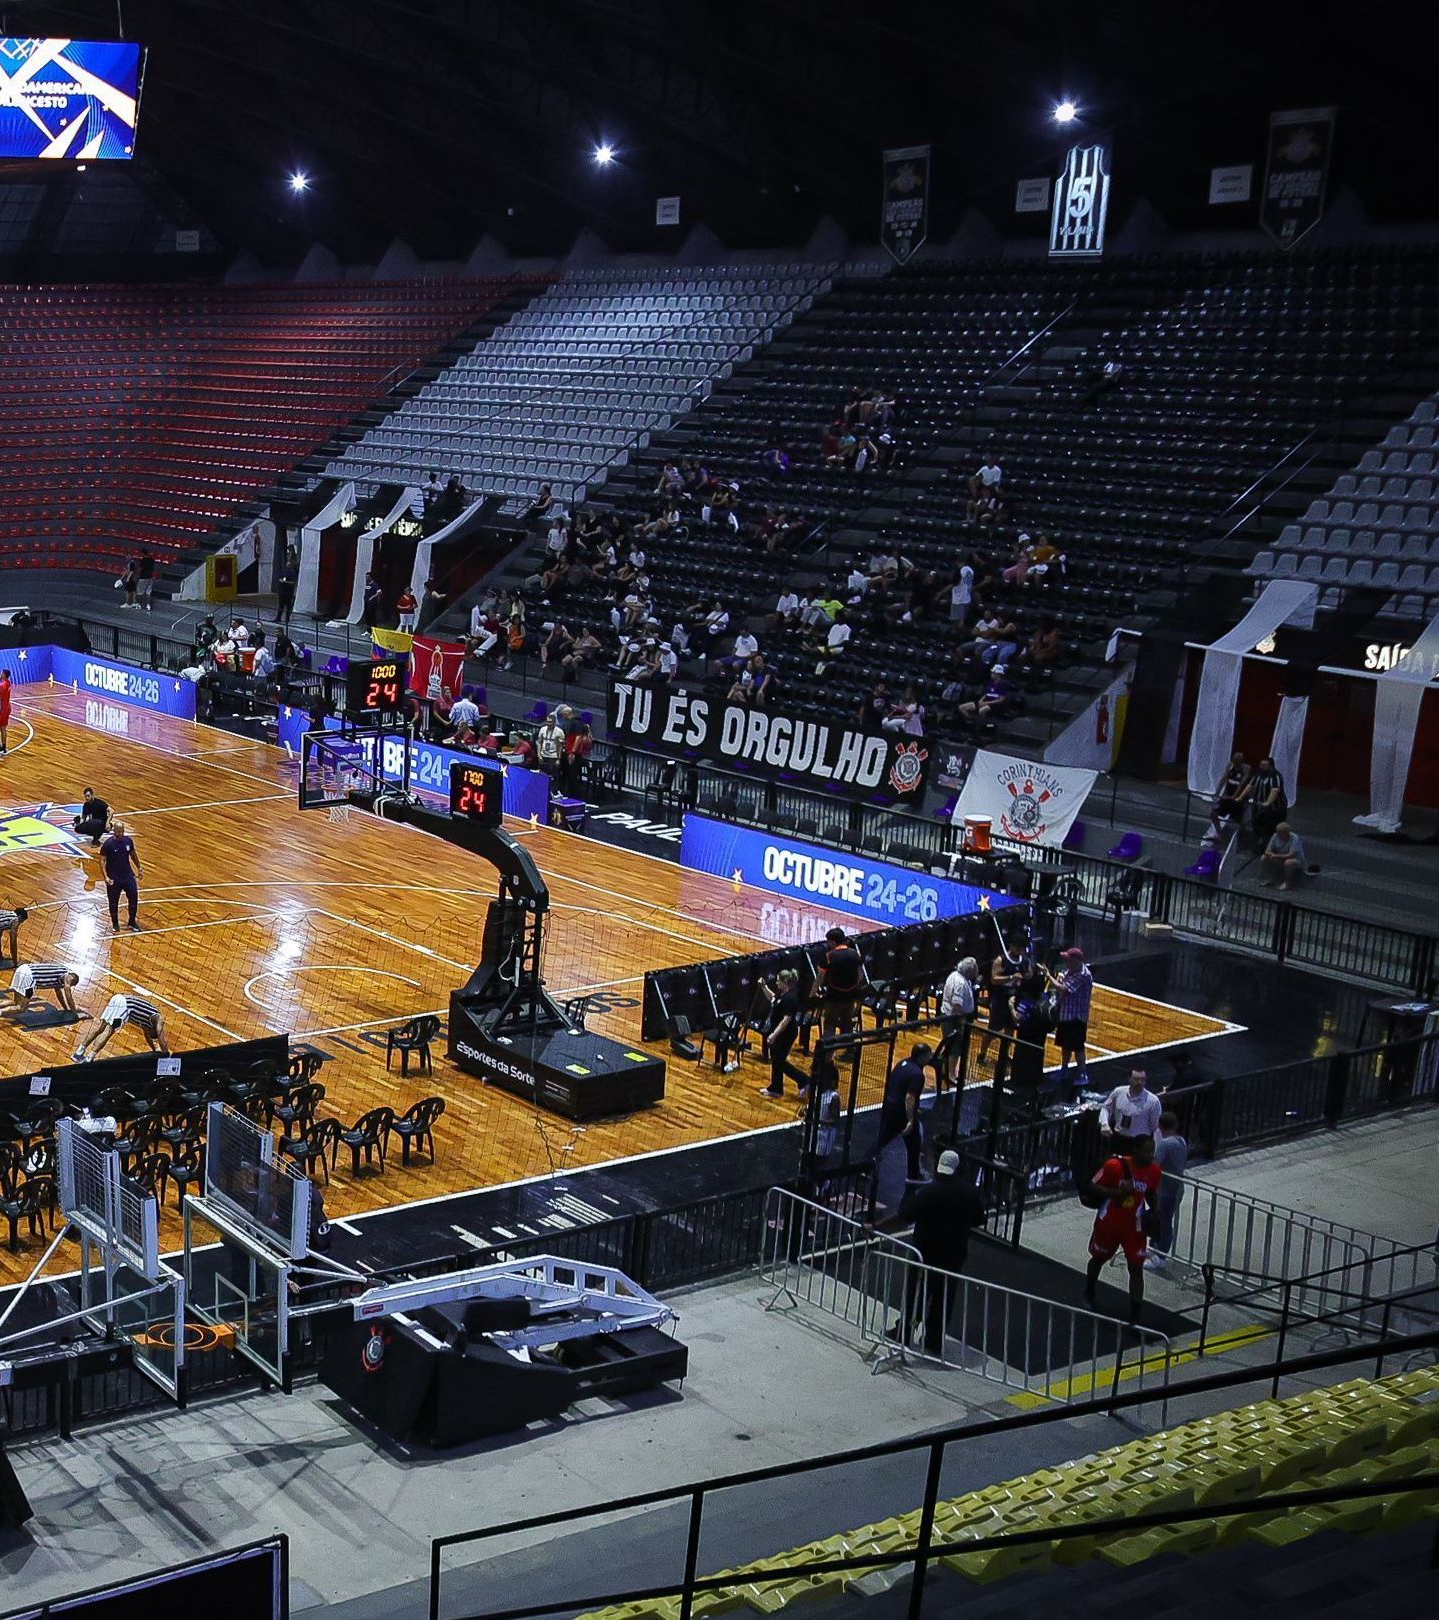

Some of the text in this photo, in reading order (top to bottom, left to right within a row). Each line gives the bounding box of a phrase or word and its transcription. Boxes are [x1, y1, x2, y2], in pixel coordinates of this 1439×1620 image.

[1069, 177, 1093, 218] 5
[85, 662, 159, 704] OCTUBRE 24-26
[366, 683, 397, 706] 24
[613, 682, 889, 789] TU ÉS ORGULHO
[460, 787, 485, 813] 24
[997, 763, 1063, 798] CORINTHIANS
[590, 812, 682, 844] PAUL
[763, 846, 939, 922] OCTUBRE 24-26
[456, 1041, 536, 1087] Esportes da Sorte
